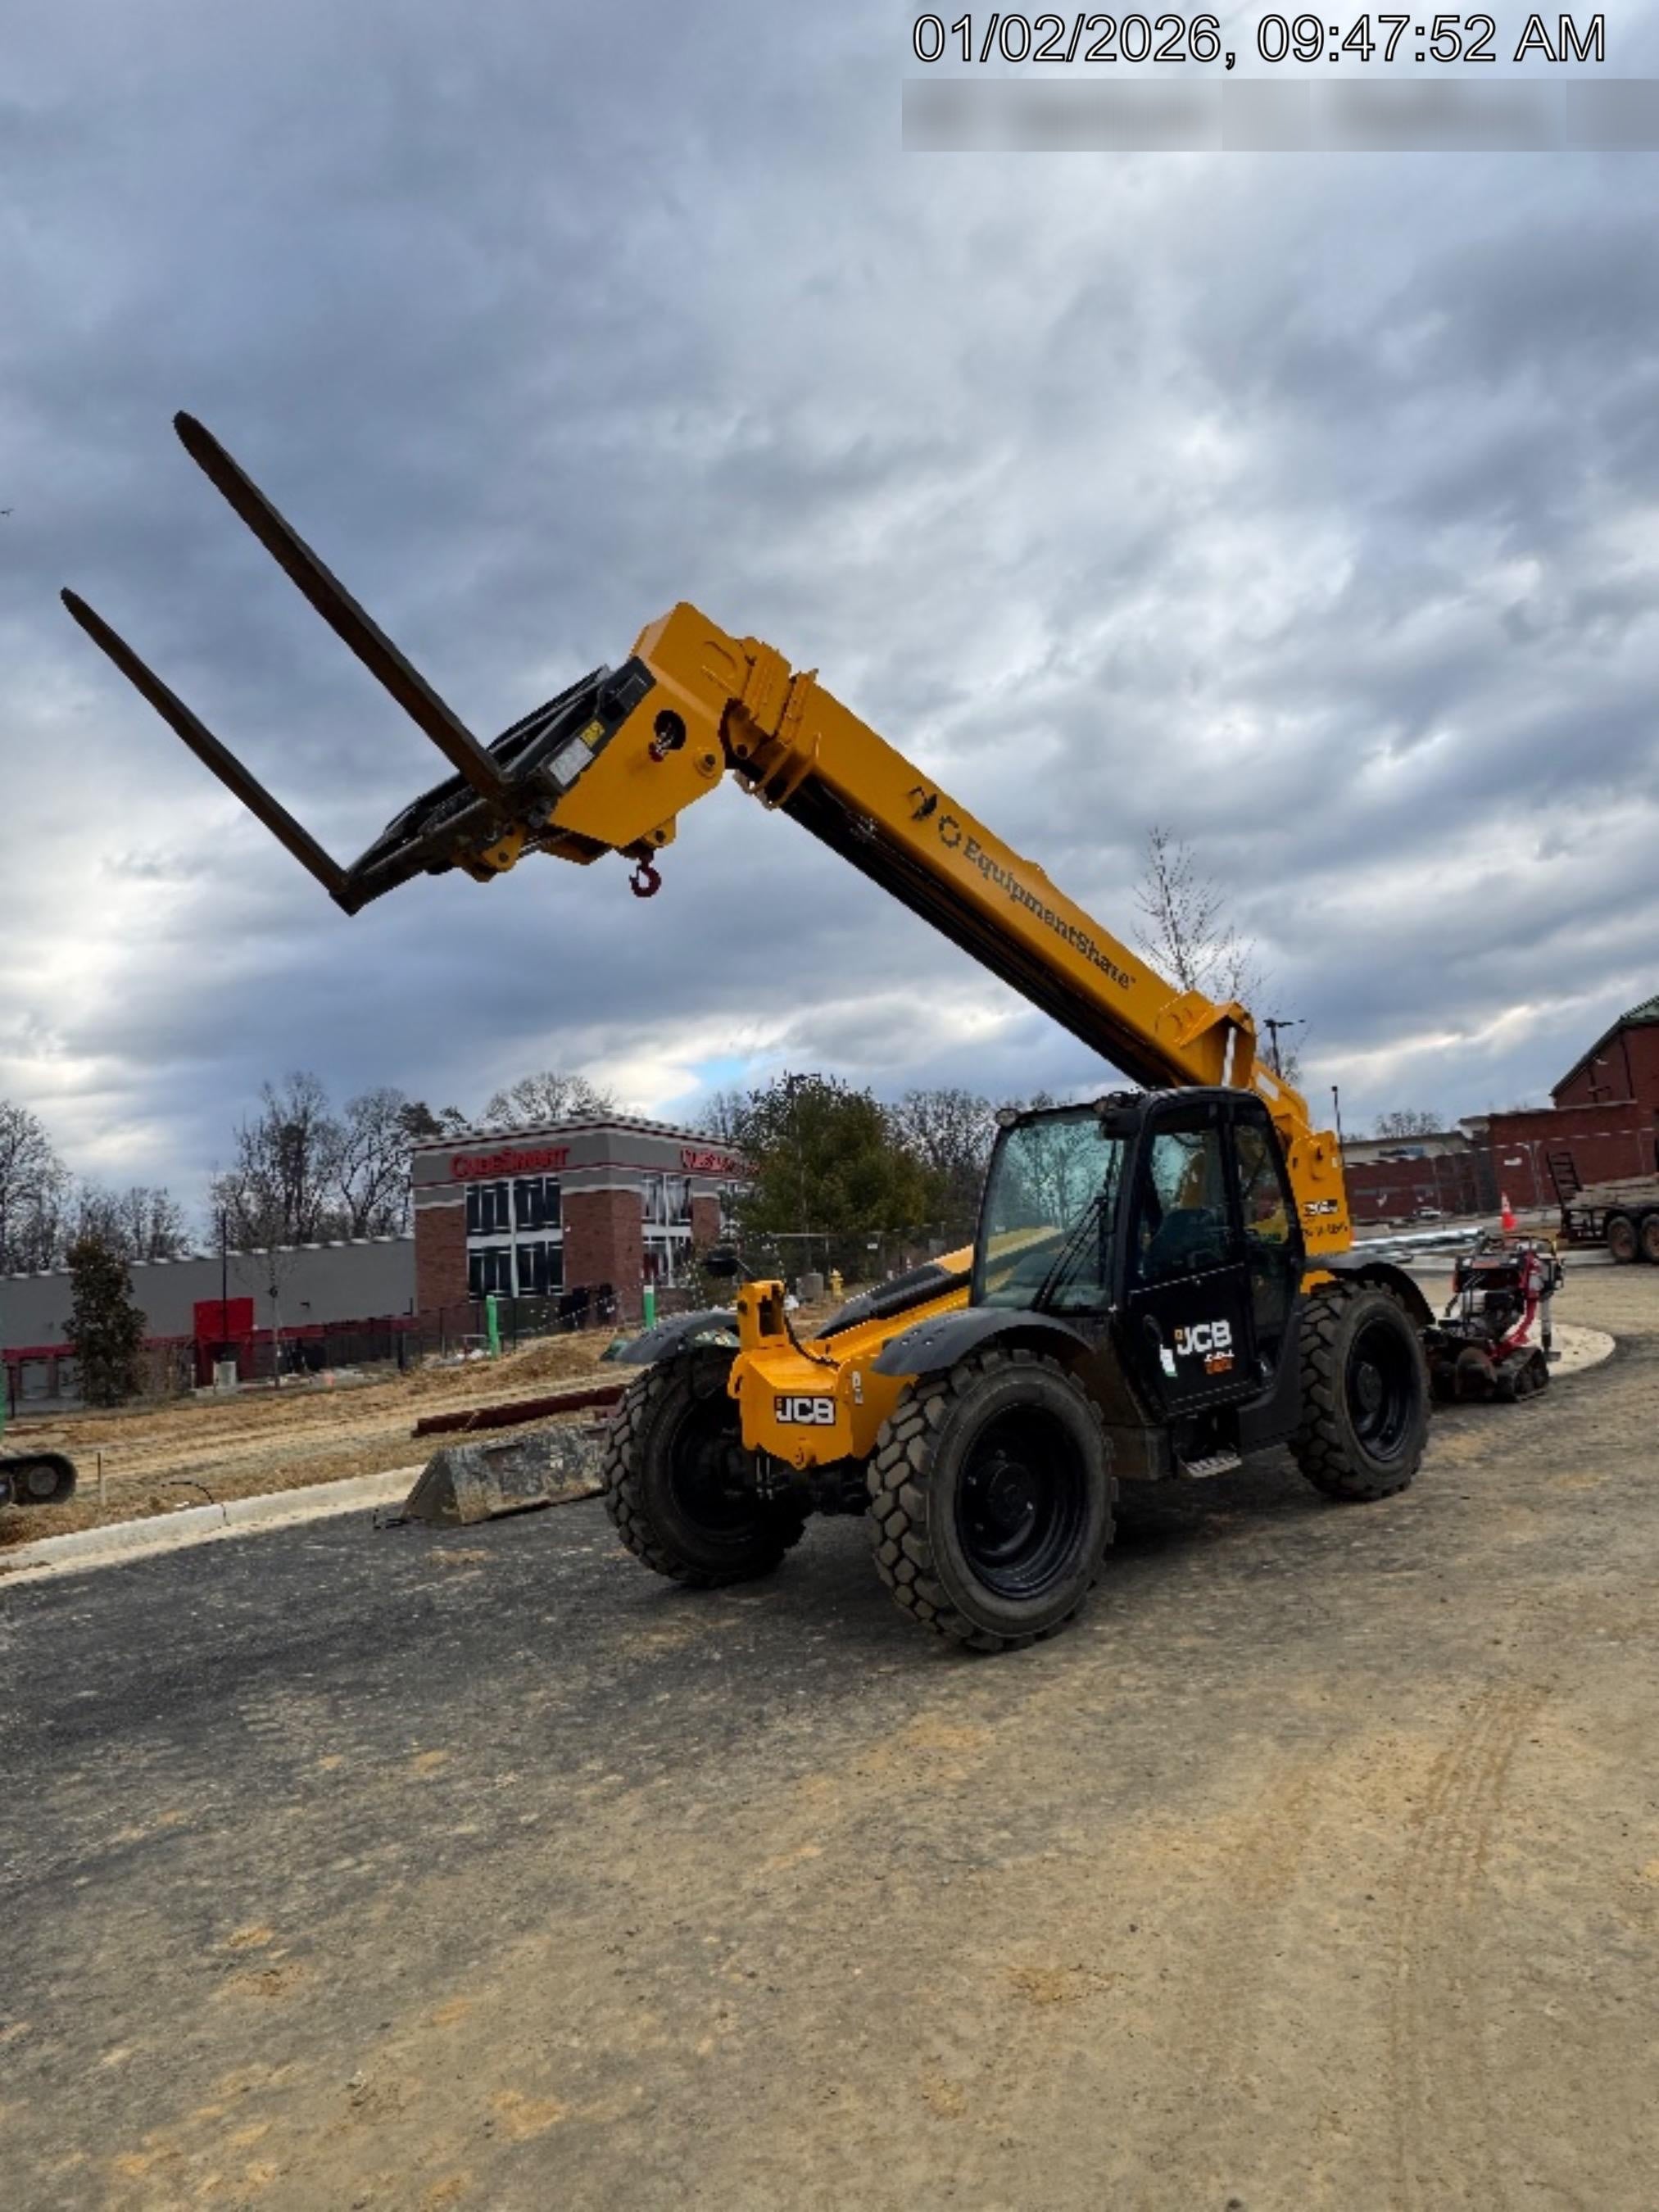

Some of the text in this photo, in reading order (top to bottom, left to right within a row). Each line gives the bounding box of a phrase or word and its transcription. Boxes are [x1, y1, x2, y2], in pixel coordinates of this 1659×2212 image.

[963, 835, 1130, 990] EquipmentShare
[1176, 1319, 1232, 1355] JCB
[776, 1396, 836, 1425] JCB
